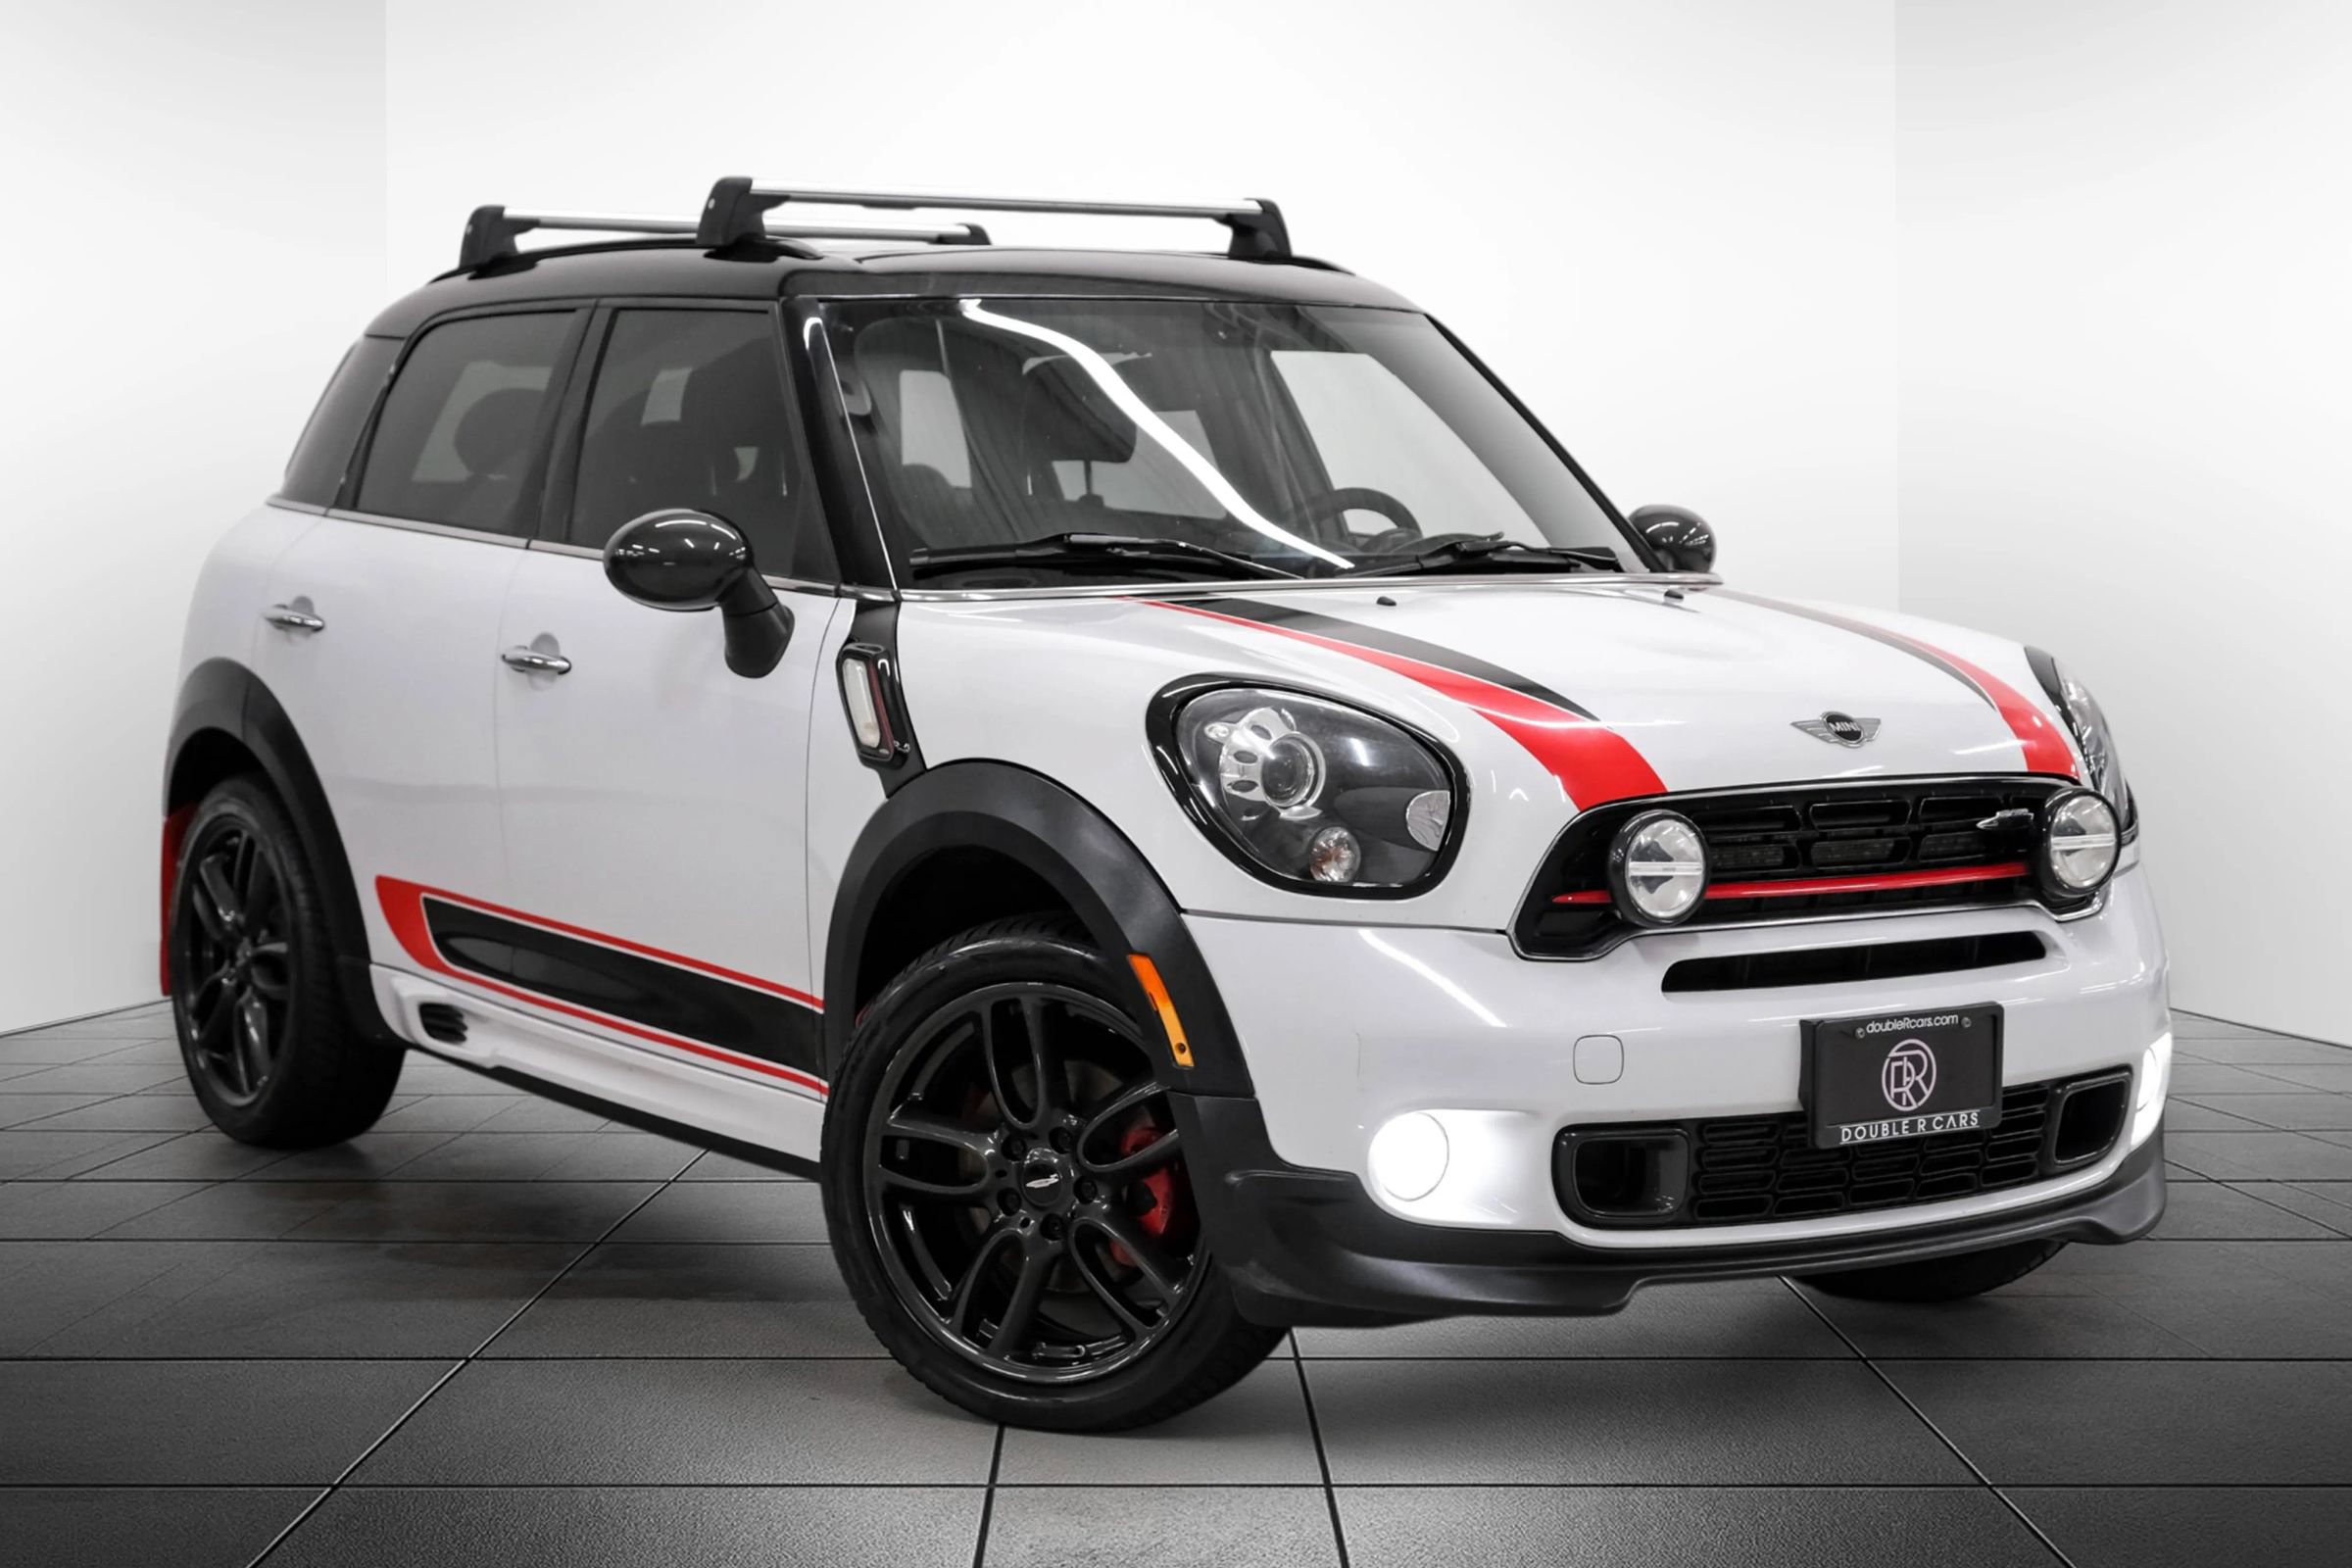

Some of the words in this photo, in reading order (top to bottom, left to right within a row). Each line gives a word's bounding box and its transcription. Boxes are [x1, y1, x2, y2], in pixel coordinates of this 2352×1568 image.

[1828, 721, 1861, 732] MINI
[1866, 1014, 1959, 1034] doubleRcars.com
[1841, 1120, 1910, 1142] DOUBLE
[1917, 1118, 1928, 1133] R
[1932, 1112, 1979, 1131] CARS
